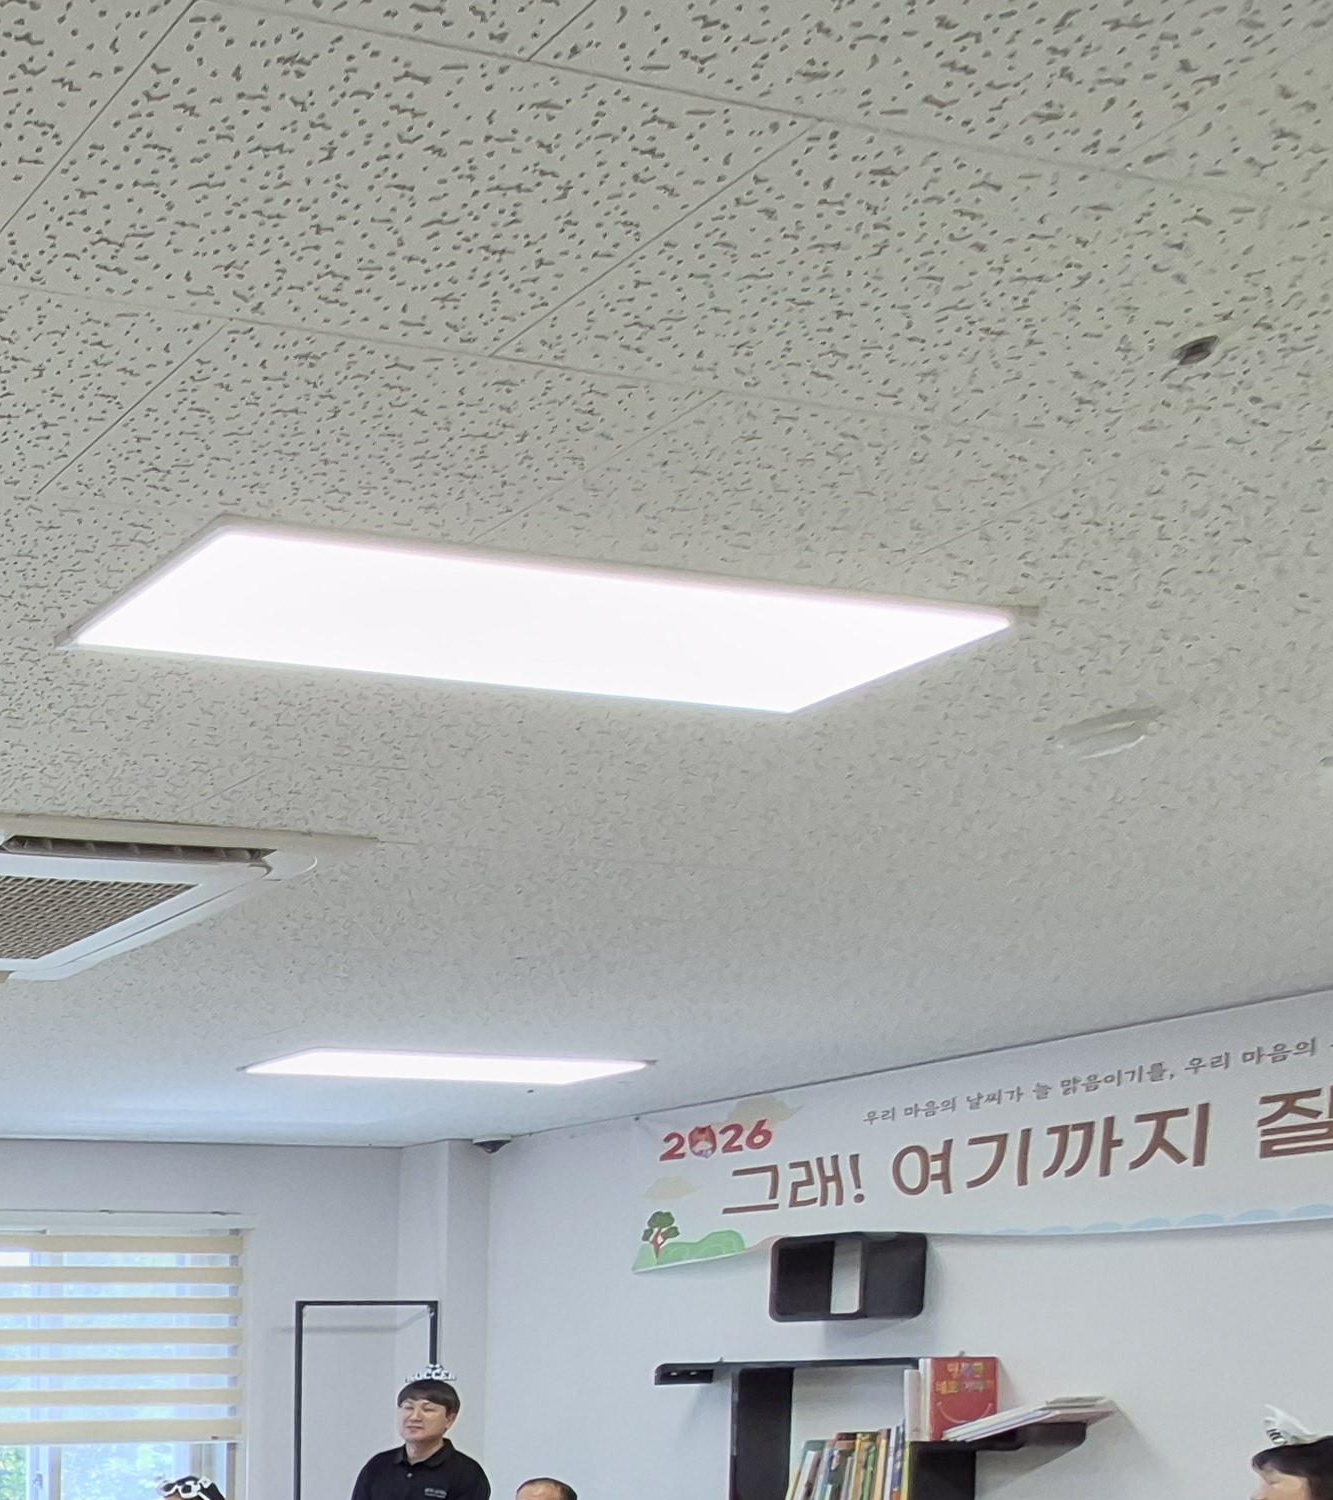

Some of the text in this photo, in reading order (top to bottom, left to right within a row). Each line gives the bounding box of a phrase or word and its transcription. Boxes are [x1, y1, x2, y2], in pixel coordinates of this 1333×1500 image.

[863, 1107, 896, 1125] 우리
[904, 1096, 957, 1118] 마음의
[966, 1086, 1024, 1110] 날씨가
[1184, 1051, 1231, 1075] 우리
[1241, 1037, 1317, 1065] 마음의
[722, 1153, 865, 1215] 그래!
[892, 1102, 1210, 1196] 여기까지
